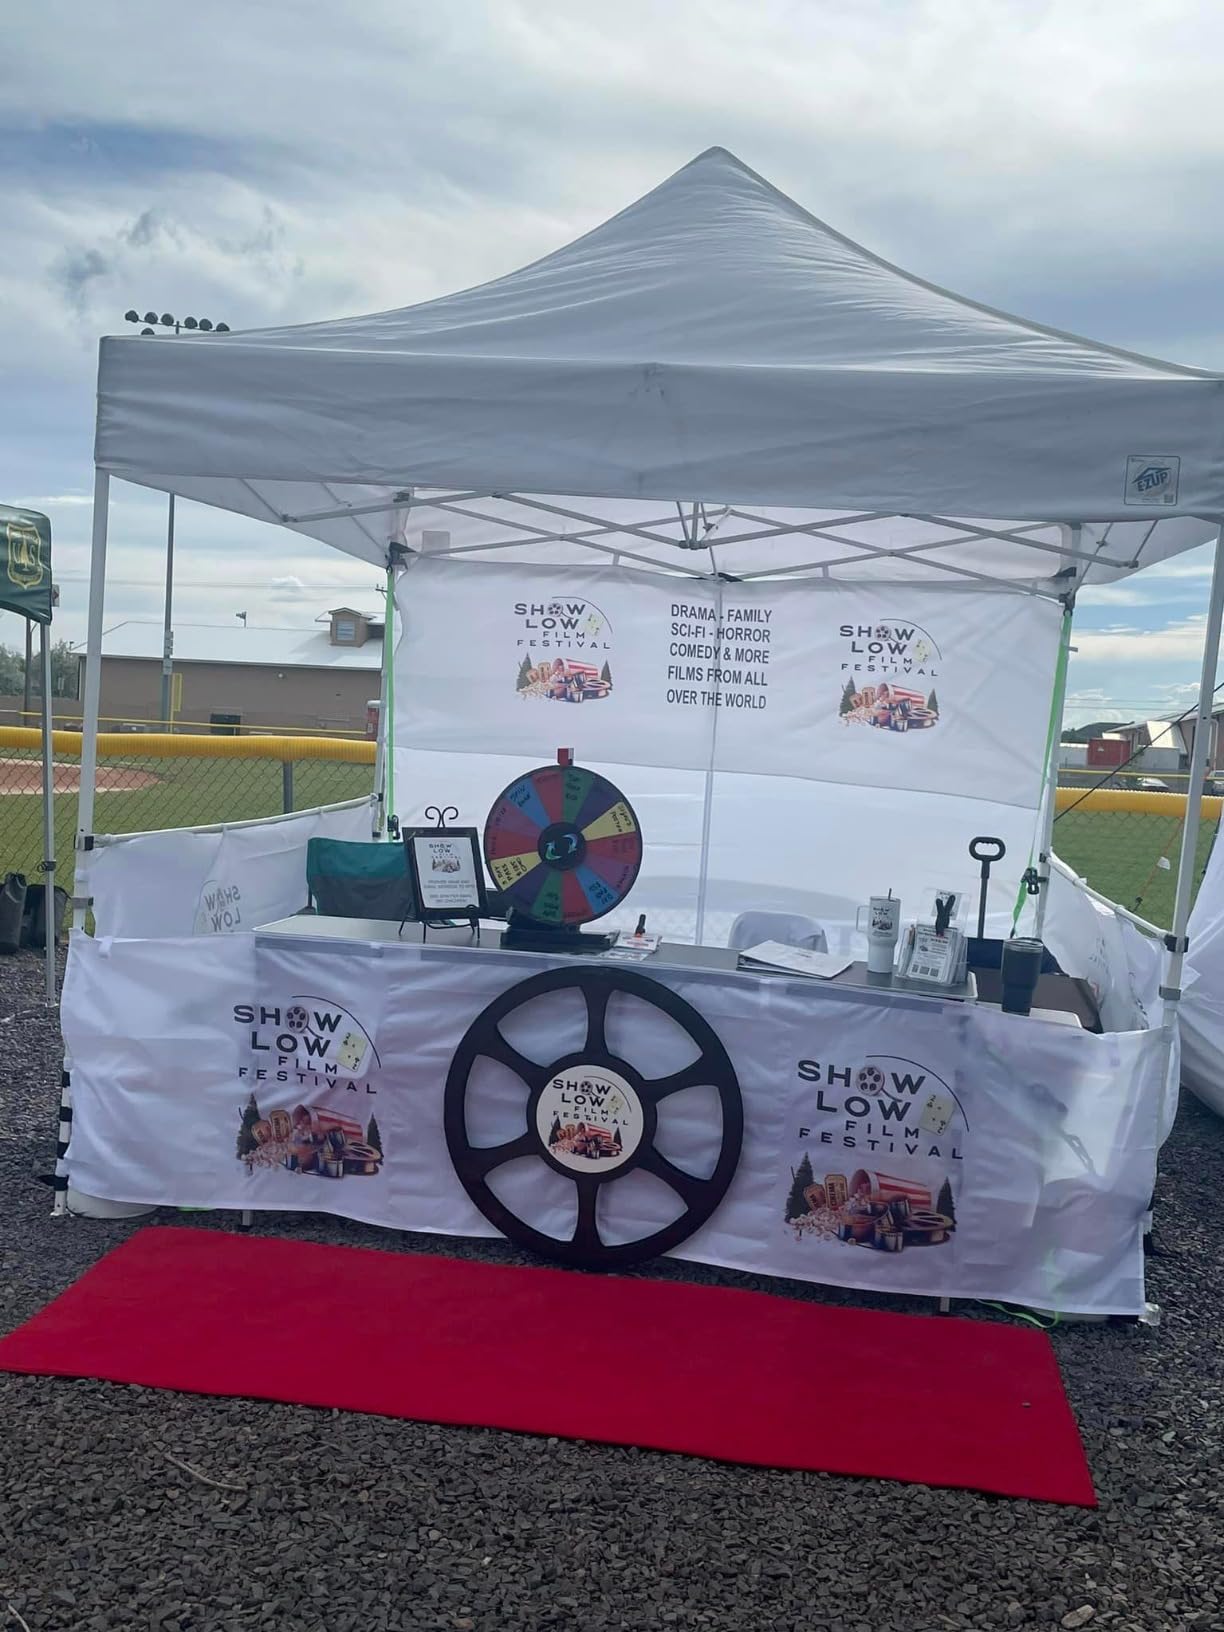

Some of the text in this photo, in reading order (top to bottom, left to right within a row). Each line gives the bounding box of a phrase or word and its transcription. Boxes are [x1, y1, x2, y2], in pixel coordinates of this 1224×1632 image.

[514, 603, 586, 617] SHOW
[671, 604, 717, 622] DRAMA
[727, 609, 772, 623] FAMILY
[525, 618, 580, 630] LOW
[671, 622, 706, 639] SCI-FI
[716, 627, 771, 643] HORROR
[839, 625, 915, 641] SHOW
[543, 631, 585, 639] FILM
[517, 640, 611, 650] FESTIVAL
[669, 642, 770, 664] COMEDY & MORE
[851, 641, 907, 655] LOW
[841, 663, 939, 677] FESTIVAL
[868, 656, 913, 665] FILM
[668, 665, 768, 686] FILMS FROM ALL
[666, 689, 766, 709] OVER THE WORLD
[233, 1004, 342, 1033] SHOW
[251, 1031, 331, 1058] LOW
[278, 1056, 337, 1075] FILM
[239, 1067, 377, 1094] FESTIVAL
[552, 1079, 611, 1095] SHOW
[797, 1059, 926, 1096] SHOW
[561, 1093, 605, 1107] LOW
[816, 1090, 912, 1122] LOW
[553, 1110, 628, 1126] FESTIVAL
[574, 1106, 608, 1115] FILM
[845, 1120, 919, 1139] FILM
[799, 1127, 963, 1160] FESTIVAL
